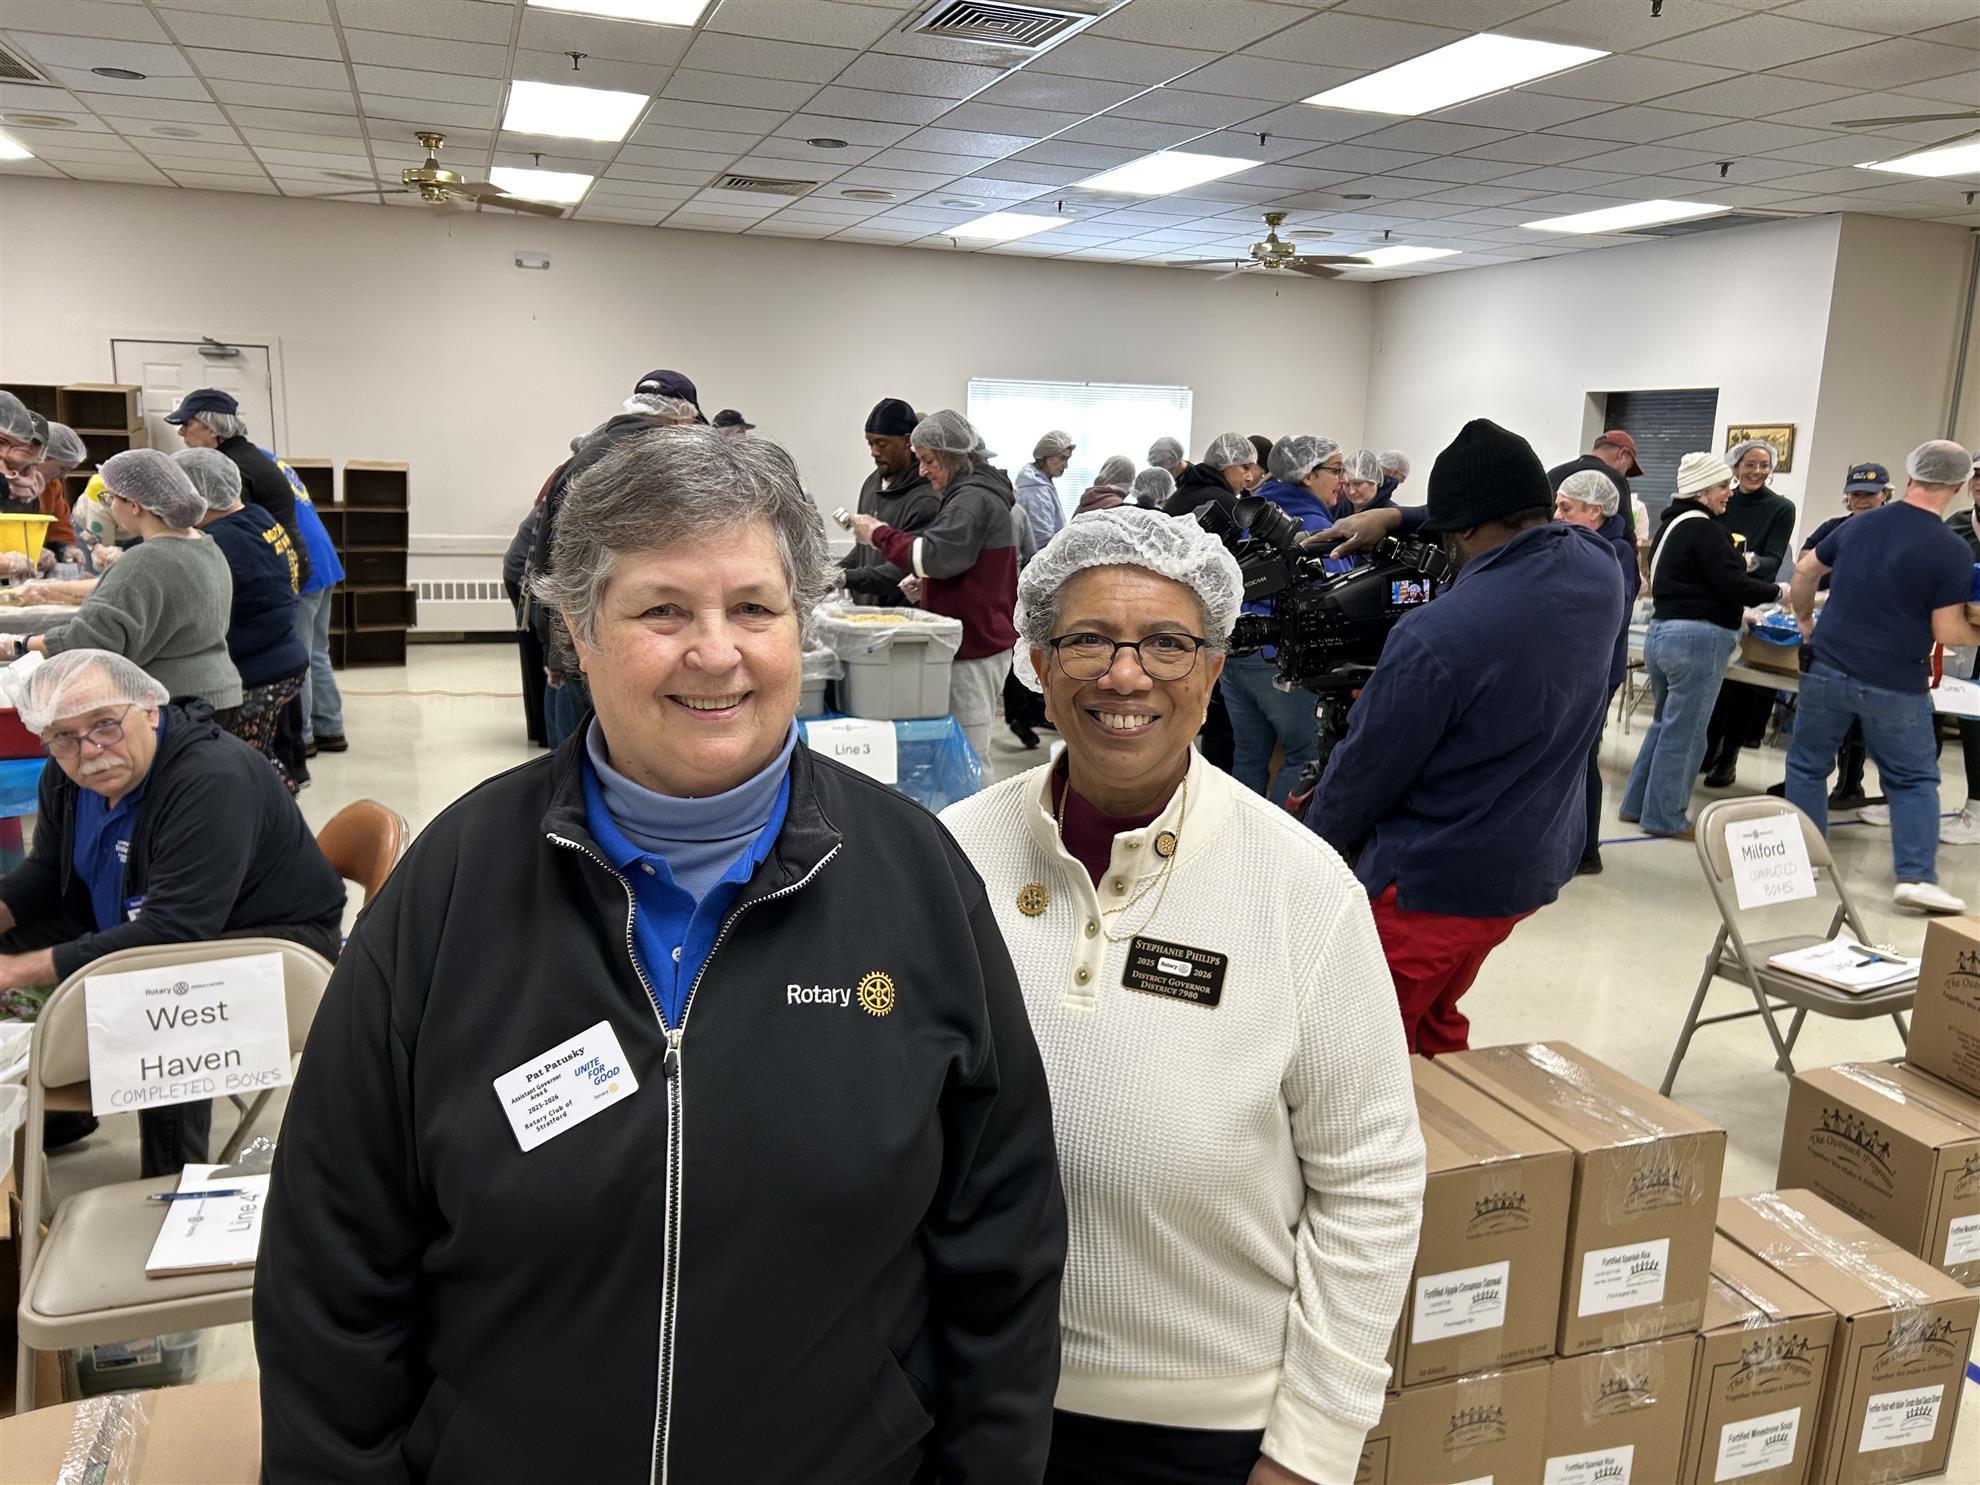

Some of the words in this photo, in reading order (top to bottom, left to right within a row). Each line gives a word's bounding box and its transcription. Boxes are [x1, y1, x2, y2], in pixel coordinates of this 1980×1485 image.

[835, 743, 860, 756] Line
[862, 743, 871, 755] 3
[1742, 840, 1785, 861] Milford
[1135, 939, 1184, 958] STEPHANIE
[1185, 950, 1221, 966] PHILIPS
[1136, 957, 1155, 967] 2025
[1193, 968, 1212, 979] 2026
[145, 987, 171, 996] Rotary
[1131, 970, 1167, 984] DISTRICT
[1168, 978, 1211, 994] GOVERNOR
[1140, 980, 1178, 995] DISTRICT
[1178, 989, 1199, 1000] 7980
[787, 984, 851, 1008] Rotary
[146, 1000, 230, 1031] West
[140, 1047, 241, 1081] Haven
[525, 1067, 544, 1084] Pat
[544, 1046, 586, 1073] Patusky
[574, 1057, 600, 1077] UNITE
[587, 1064, 606, 1080] FOR
[111, 1077, 216, 1107] COMPLETED
[225, 1068, 283, 1089] BOXES
[593, 1066, 621, 1087] GOOD
[511, 1085, 536, 1105] Assistant
[536, 1074, 562, 1092] Governor
[530, 1091, 543, 1101] Area
[524, 1113, 547, 1131] Rotary
[548, 1104, 564, 1117] Club
[565, 1099, 573, 1108] of
[528, 1094, 559, 1115] 2025-2026
[536, 1111, 568, 1132] Stratford
[1809, 1134, 1824, 1146] The
[1826, 1136, 1862, 1159] Outreach
[227, 1203, 257, 1232] Line
